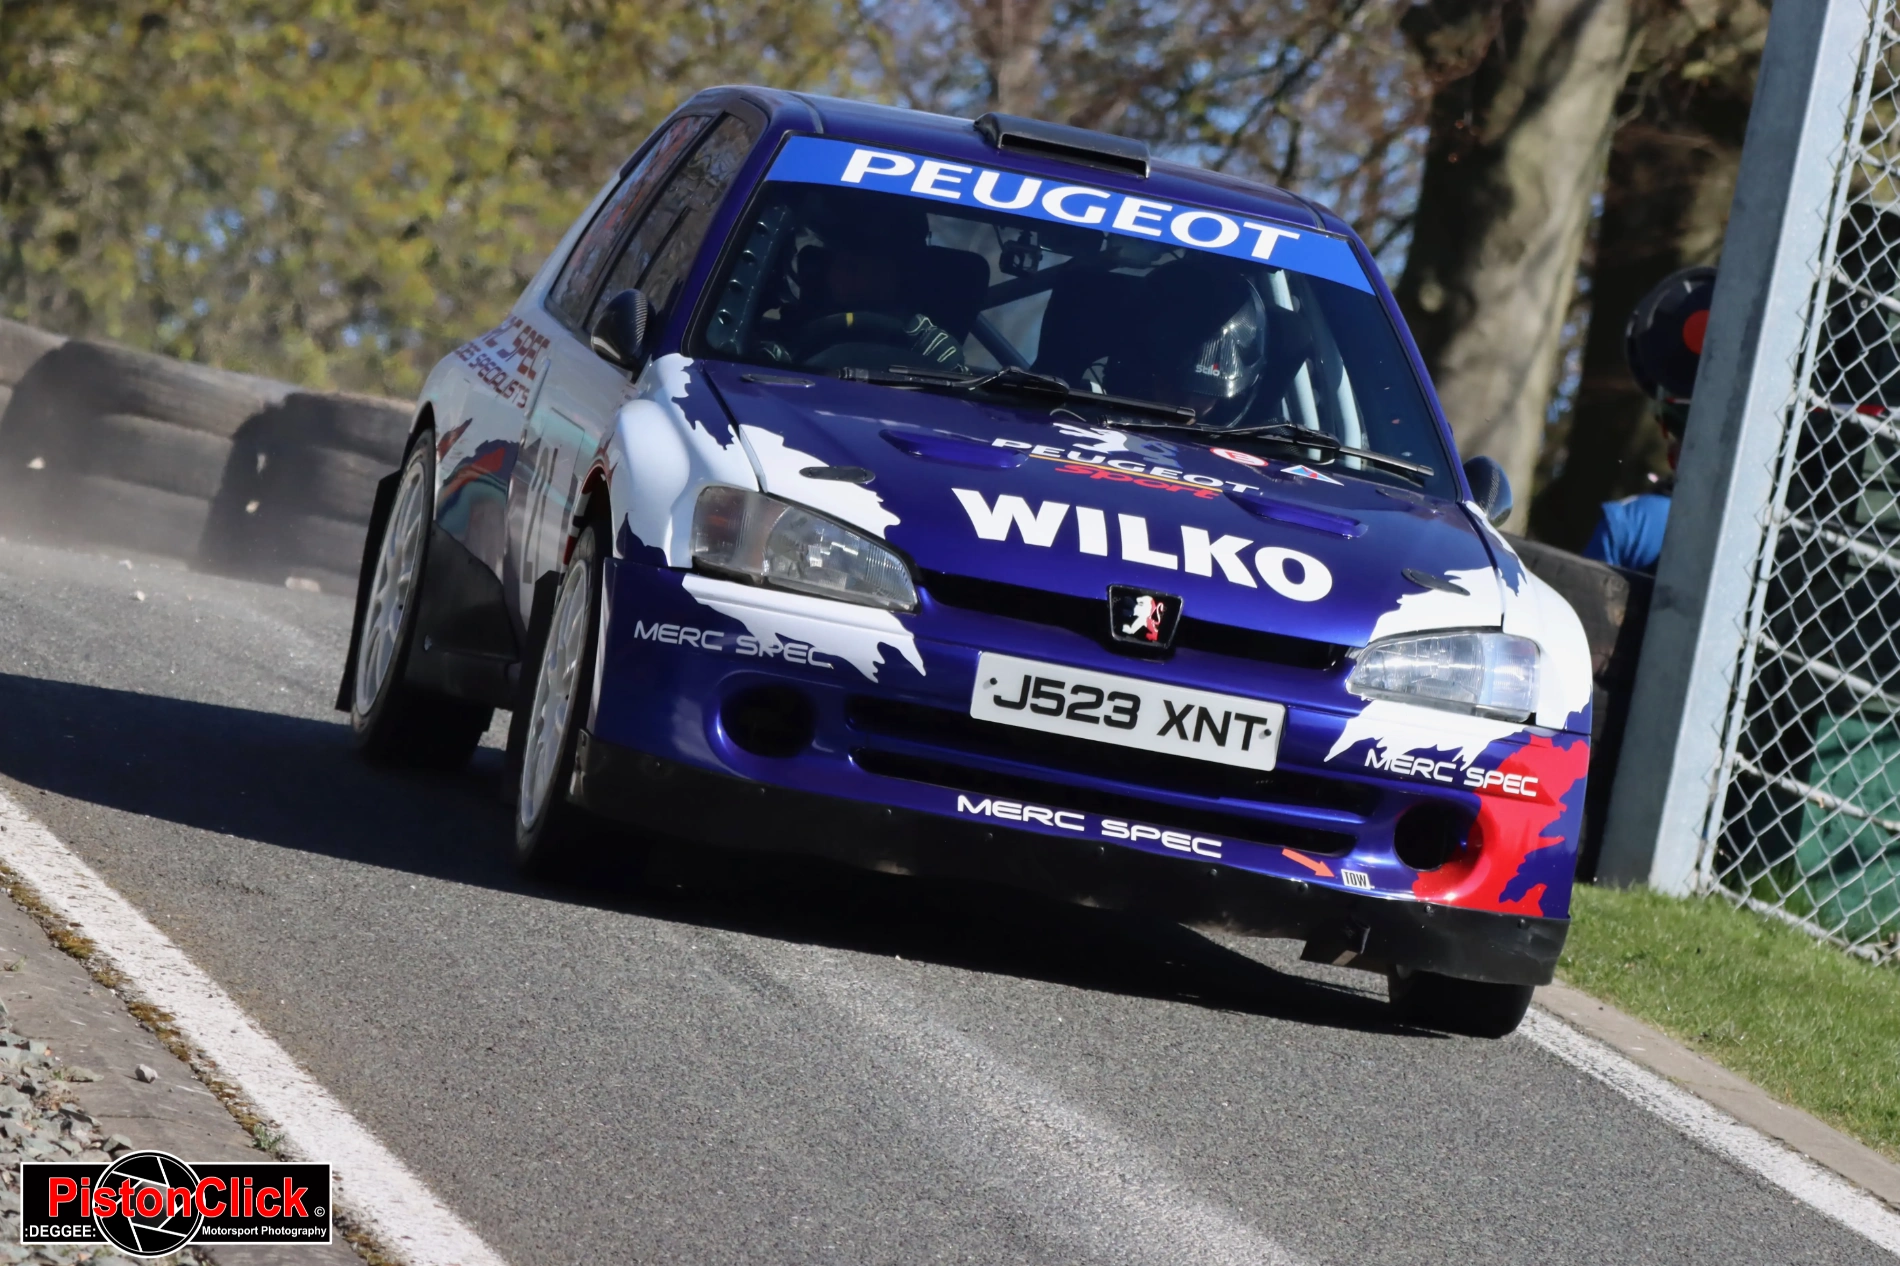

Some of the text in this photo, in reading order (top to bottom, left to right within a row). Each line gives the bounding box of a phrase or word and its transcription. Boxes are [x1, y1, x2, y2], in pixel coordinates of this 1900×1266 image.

[840, 148, 1300, 260] PEUGEOT
[496, 325, 550, 380] SPEC
[468, 353, 530, 408] SPECIALISTS
[991, 438, 1250, 493] PEUGEOT
[1055, 463, 1219, 499] sport
[951, 487, 1333, 602] WILKO
[634, 620, 834, 669] MERC SPEC
[993, 674, 1268, 752] J523 XNT
[1364, 748, 1538, 797] MERC SPEC
[957, 794, 1222, 859] MERC SPEC
[1344, 871, 1368, 887] TOW
